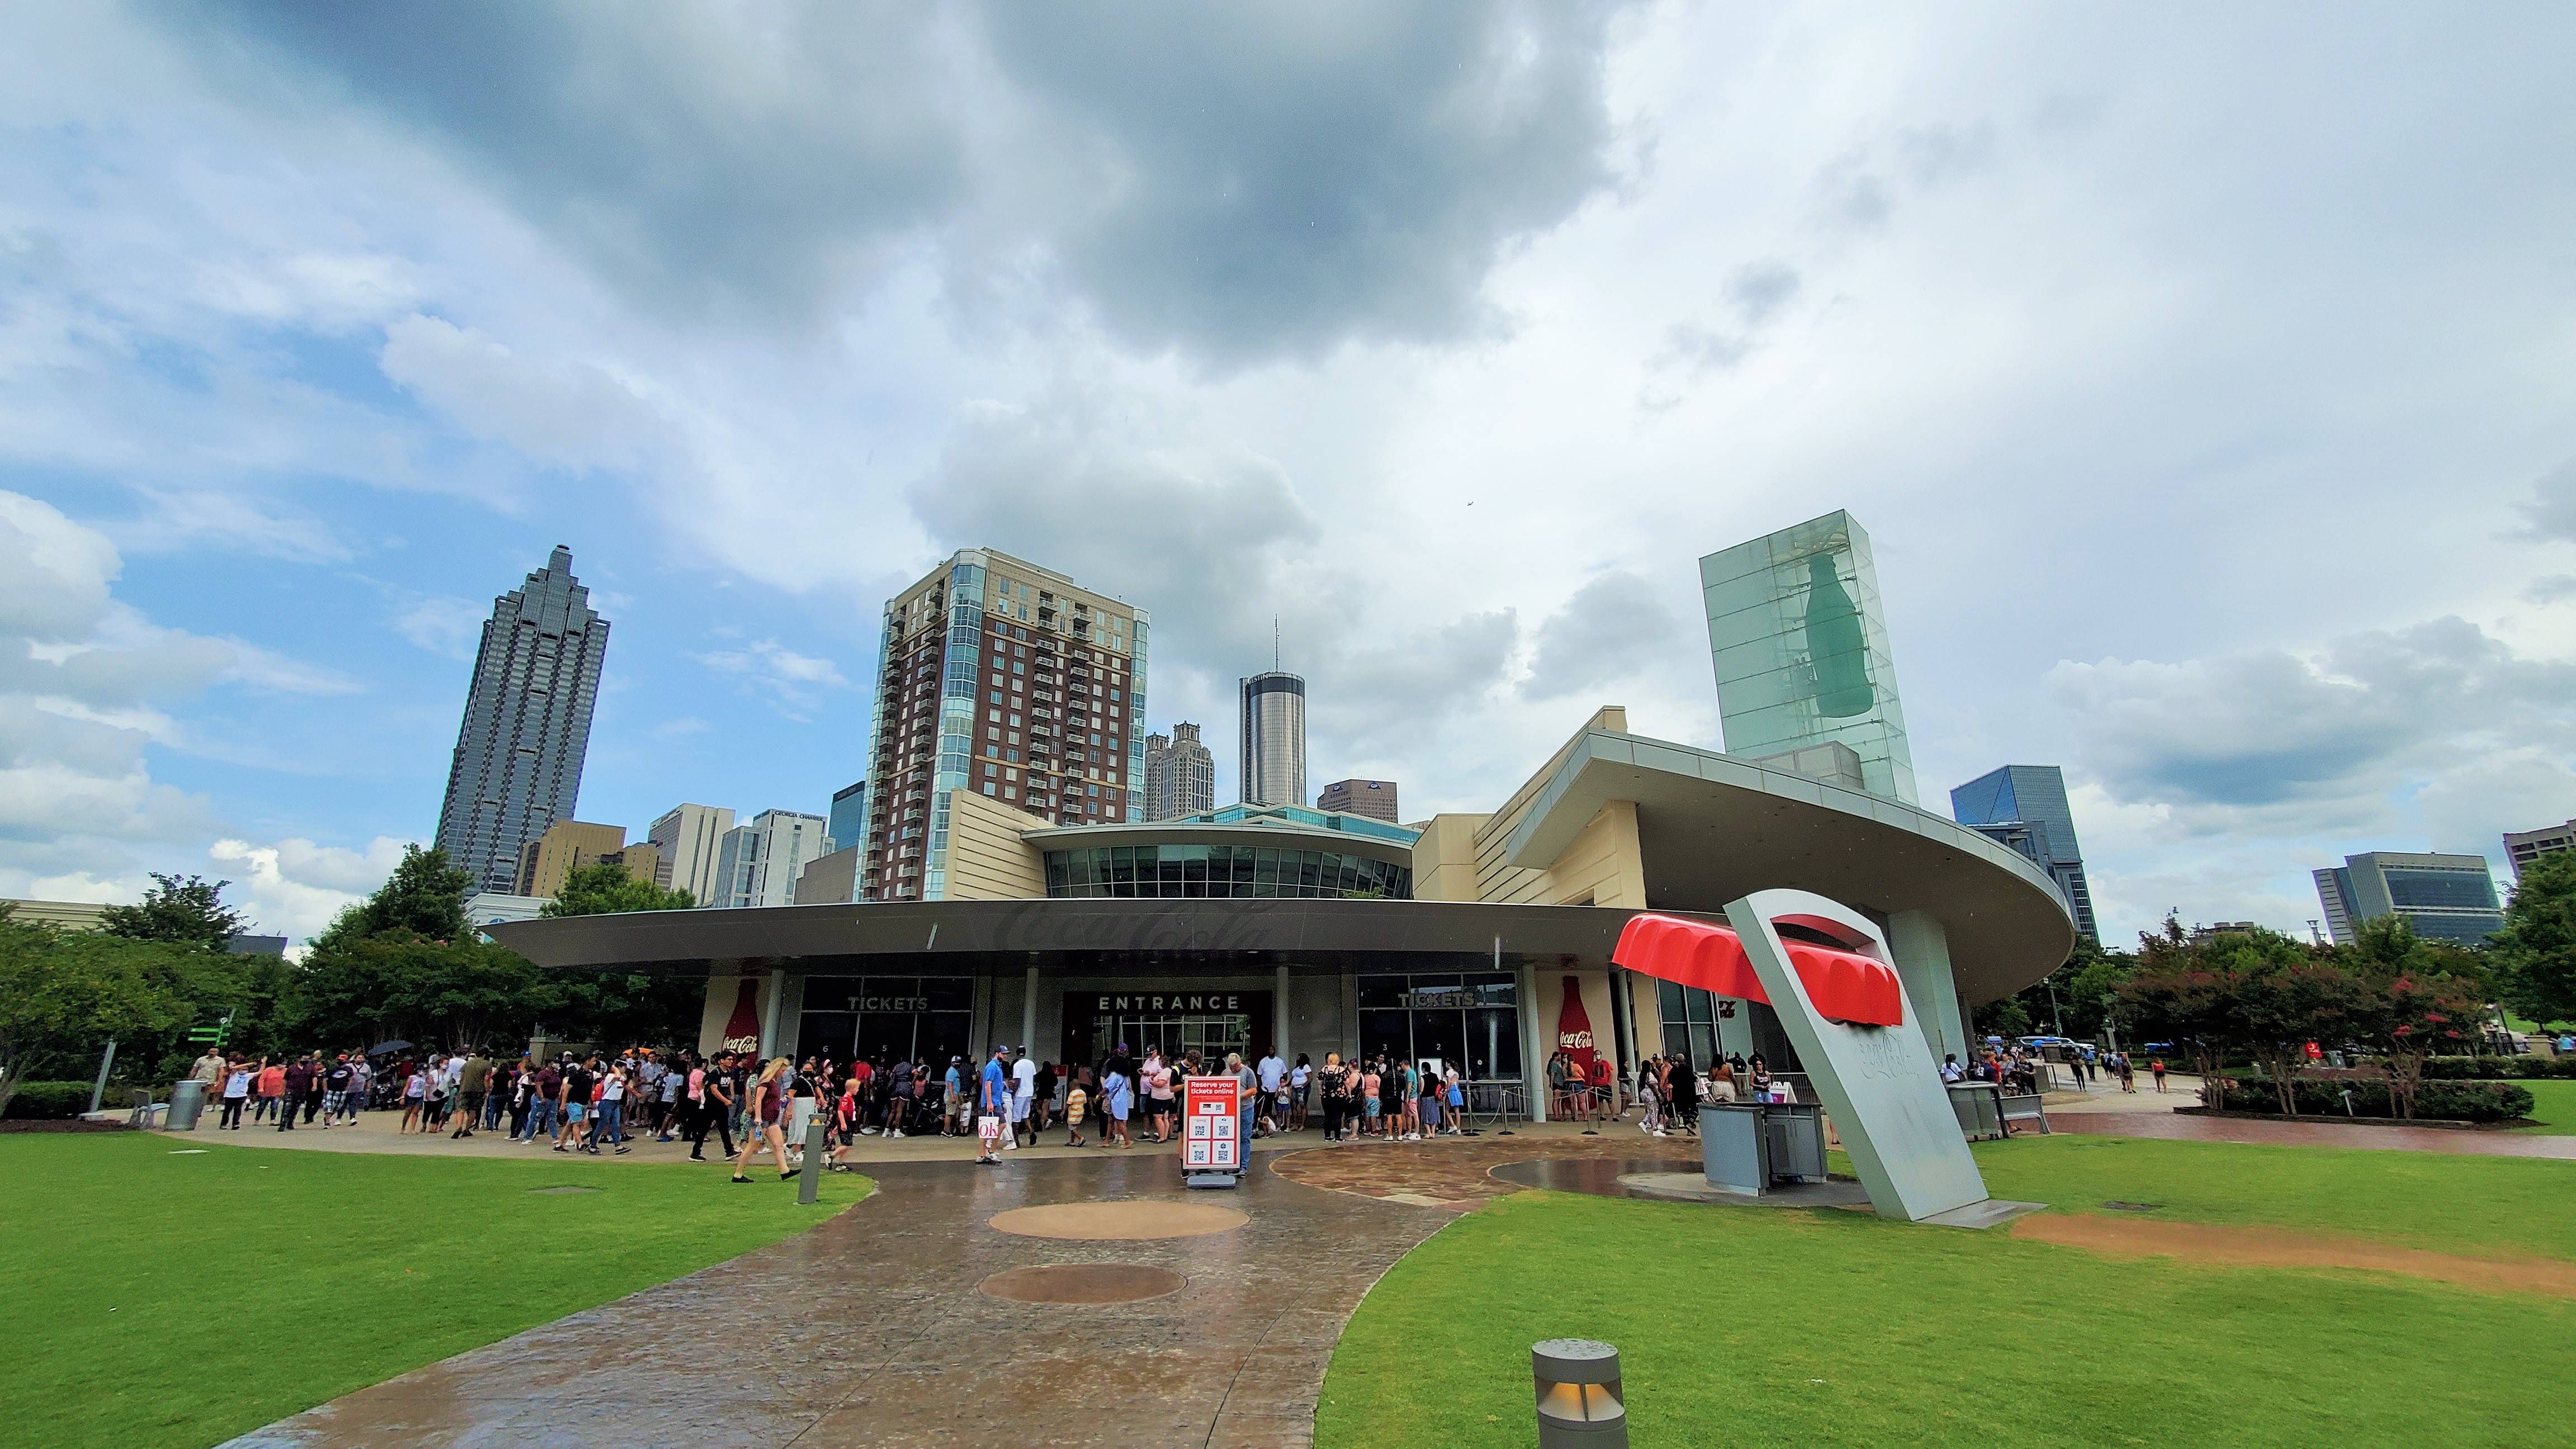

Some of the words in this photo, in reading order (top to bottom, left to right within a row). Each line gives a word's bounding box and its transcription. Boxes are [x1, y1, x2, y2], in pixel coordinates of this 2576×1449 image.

[847, 997, 929, 1010] TICKETS
[1099, 996, 1238, 1010] ENTRANCE
[1398, 992, 1475, 1007] TICKETS
